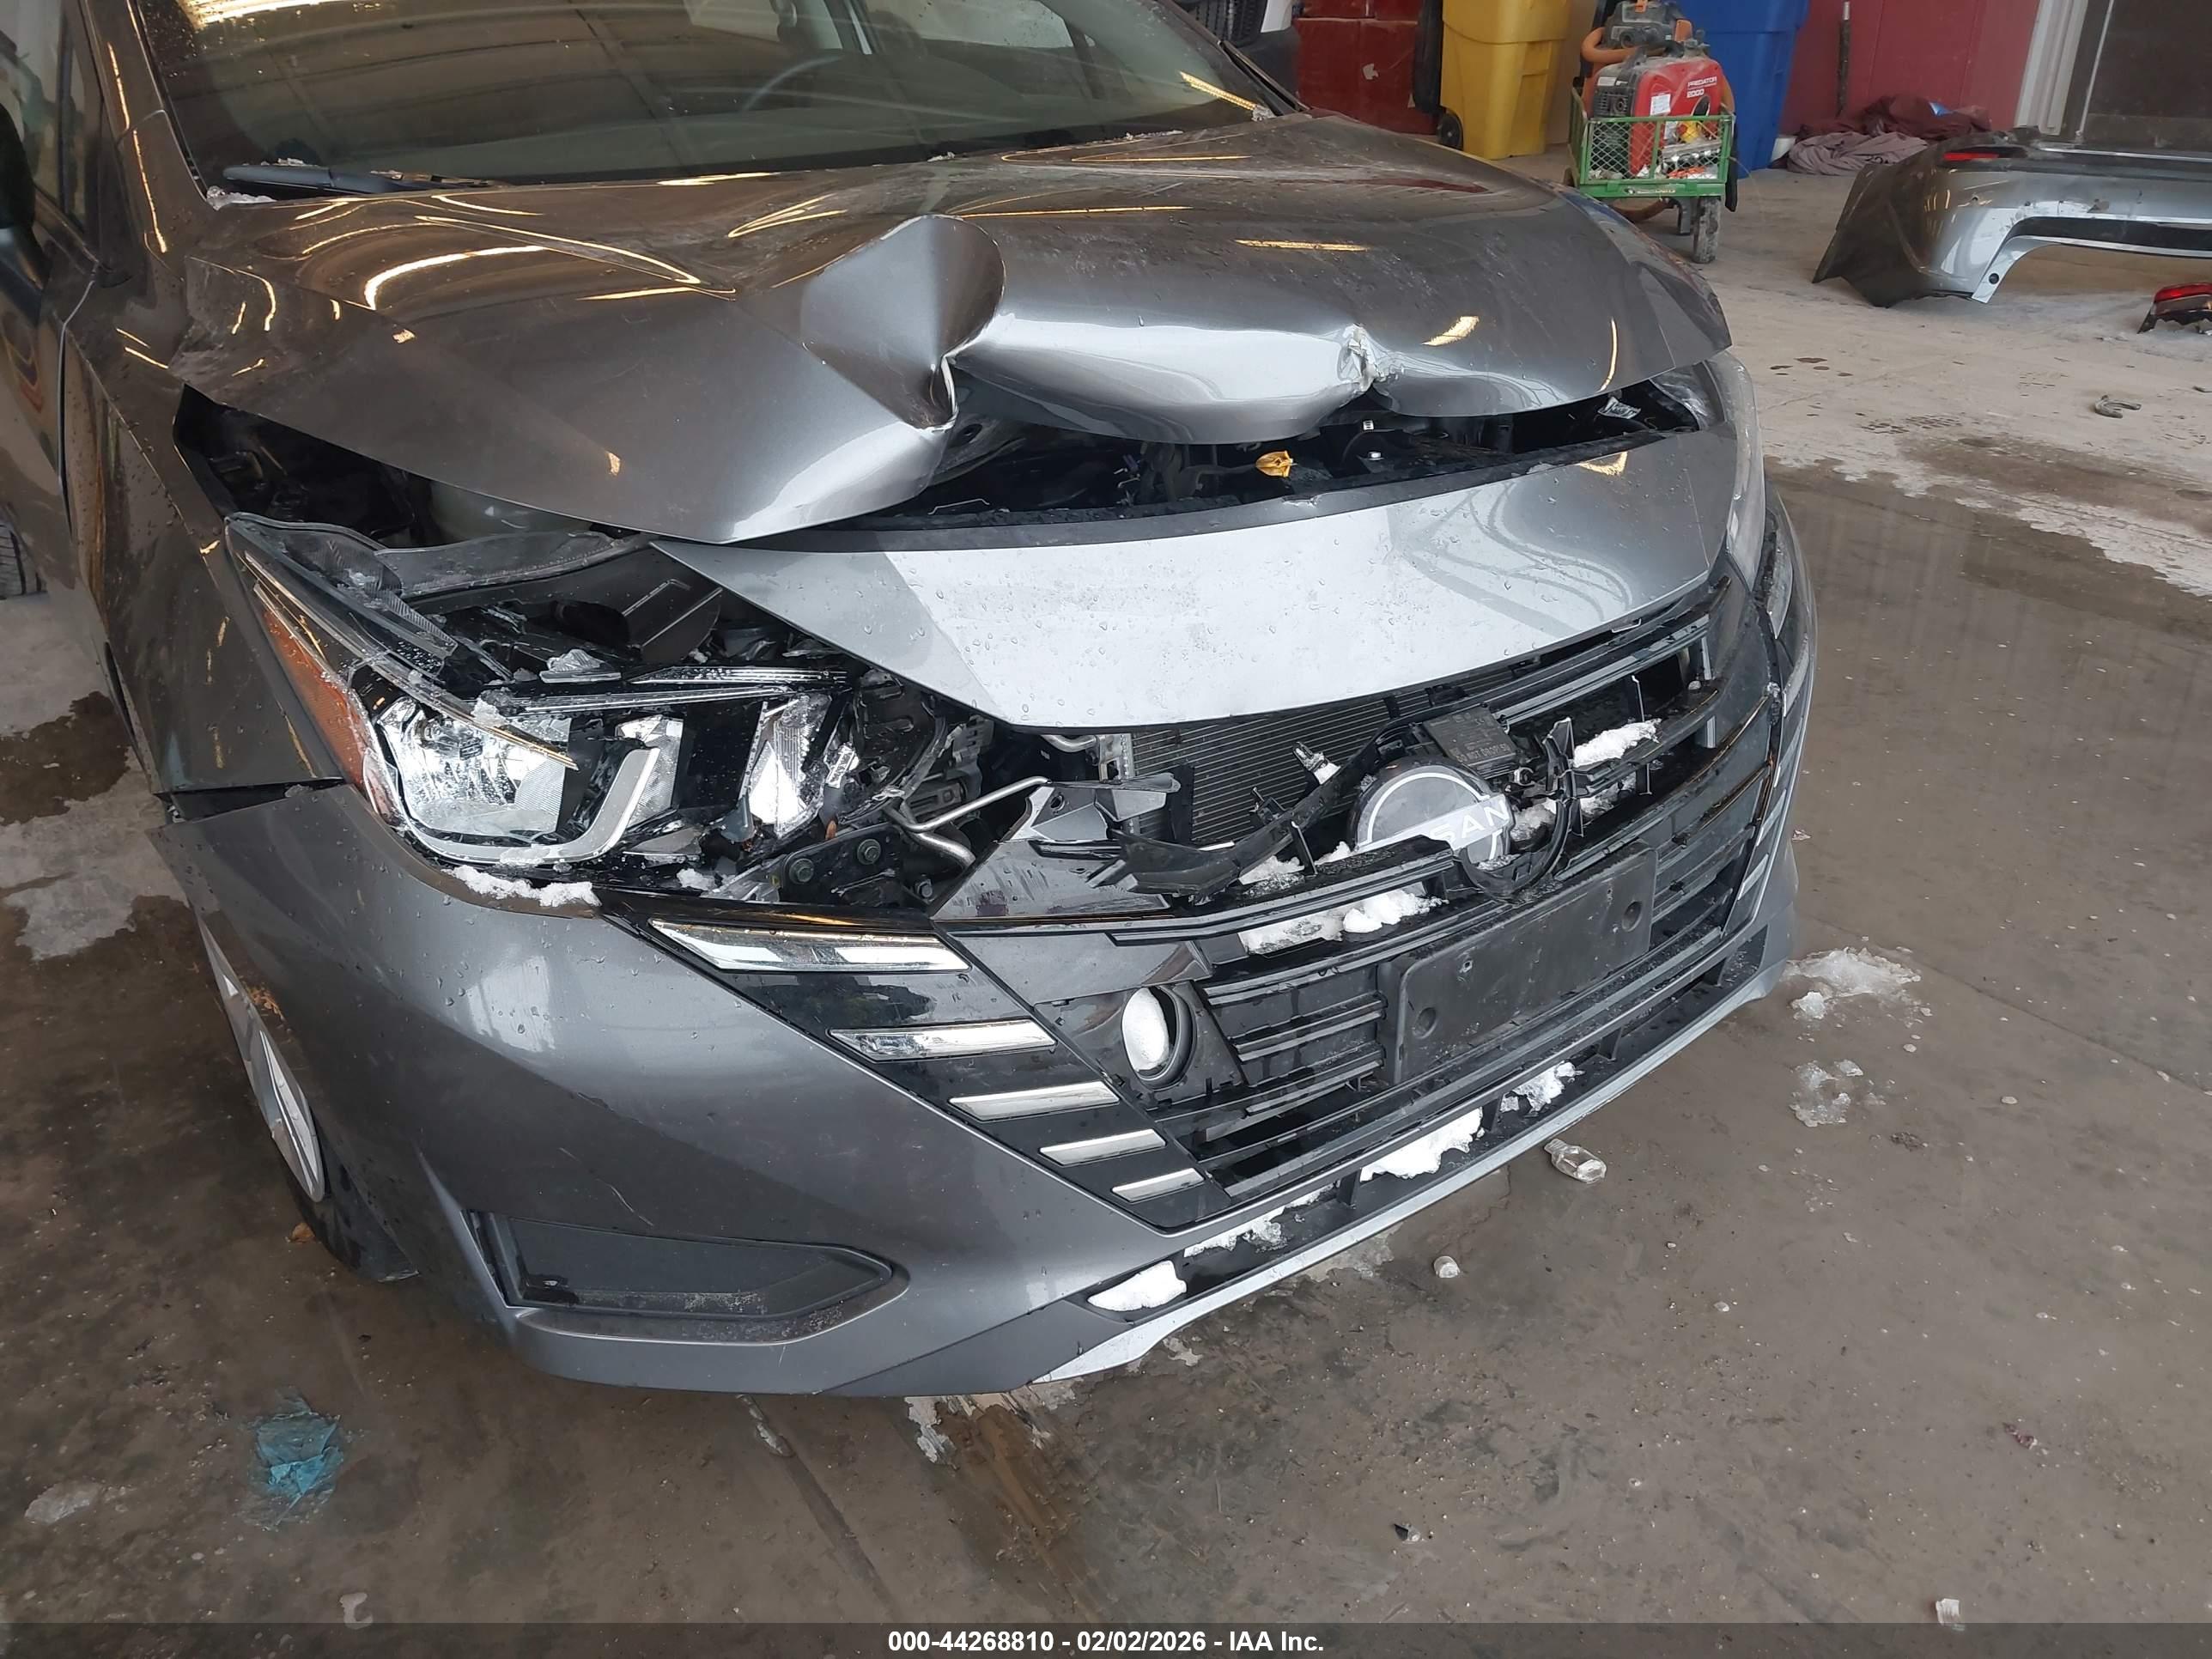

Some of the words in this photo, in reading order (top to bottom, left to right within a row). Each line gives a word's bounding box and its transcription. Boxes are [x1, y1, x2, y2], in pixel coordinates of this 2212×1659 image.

[1687, 76, 1717, 88] PREDATOR
[1686, 88, 1705, 98] 2000
[1429, 799, 1510, 844] SAN
